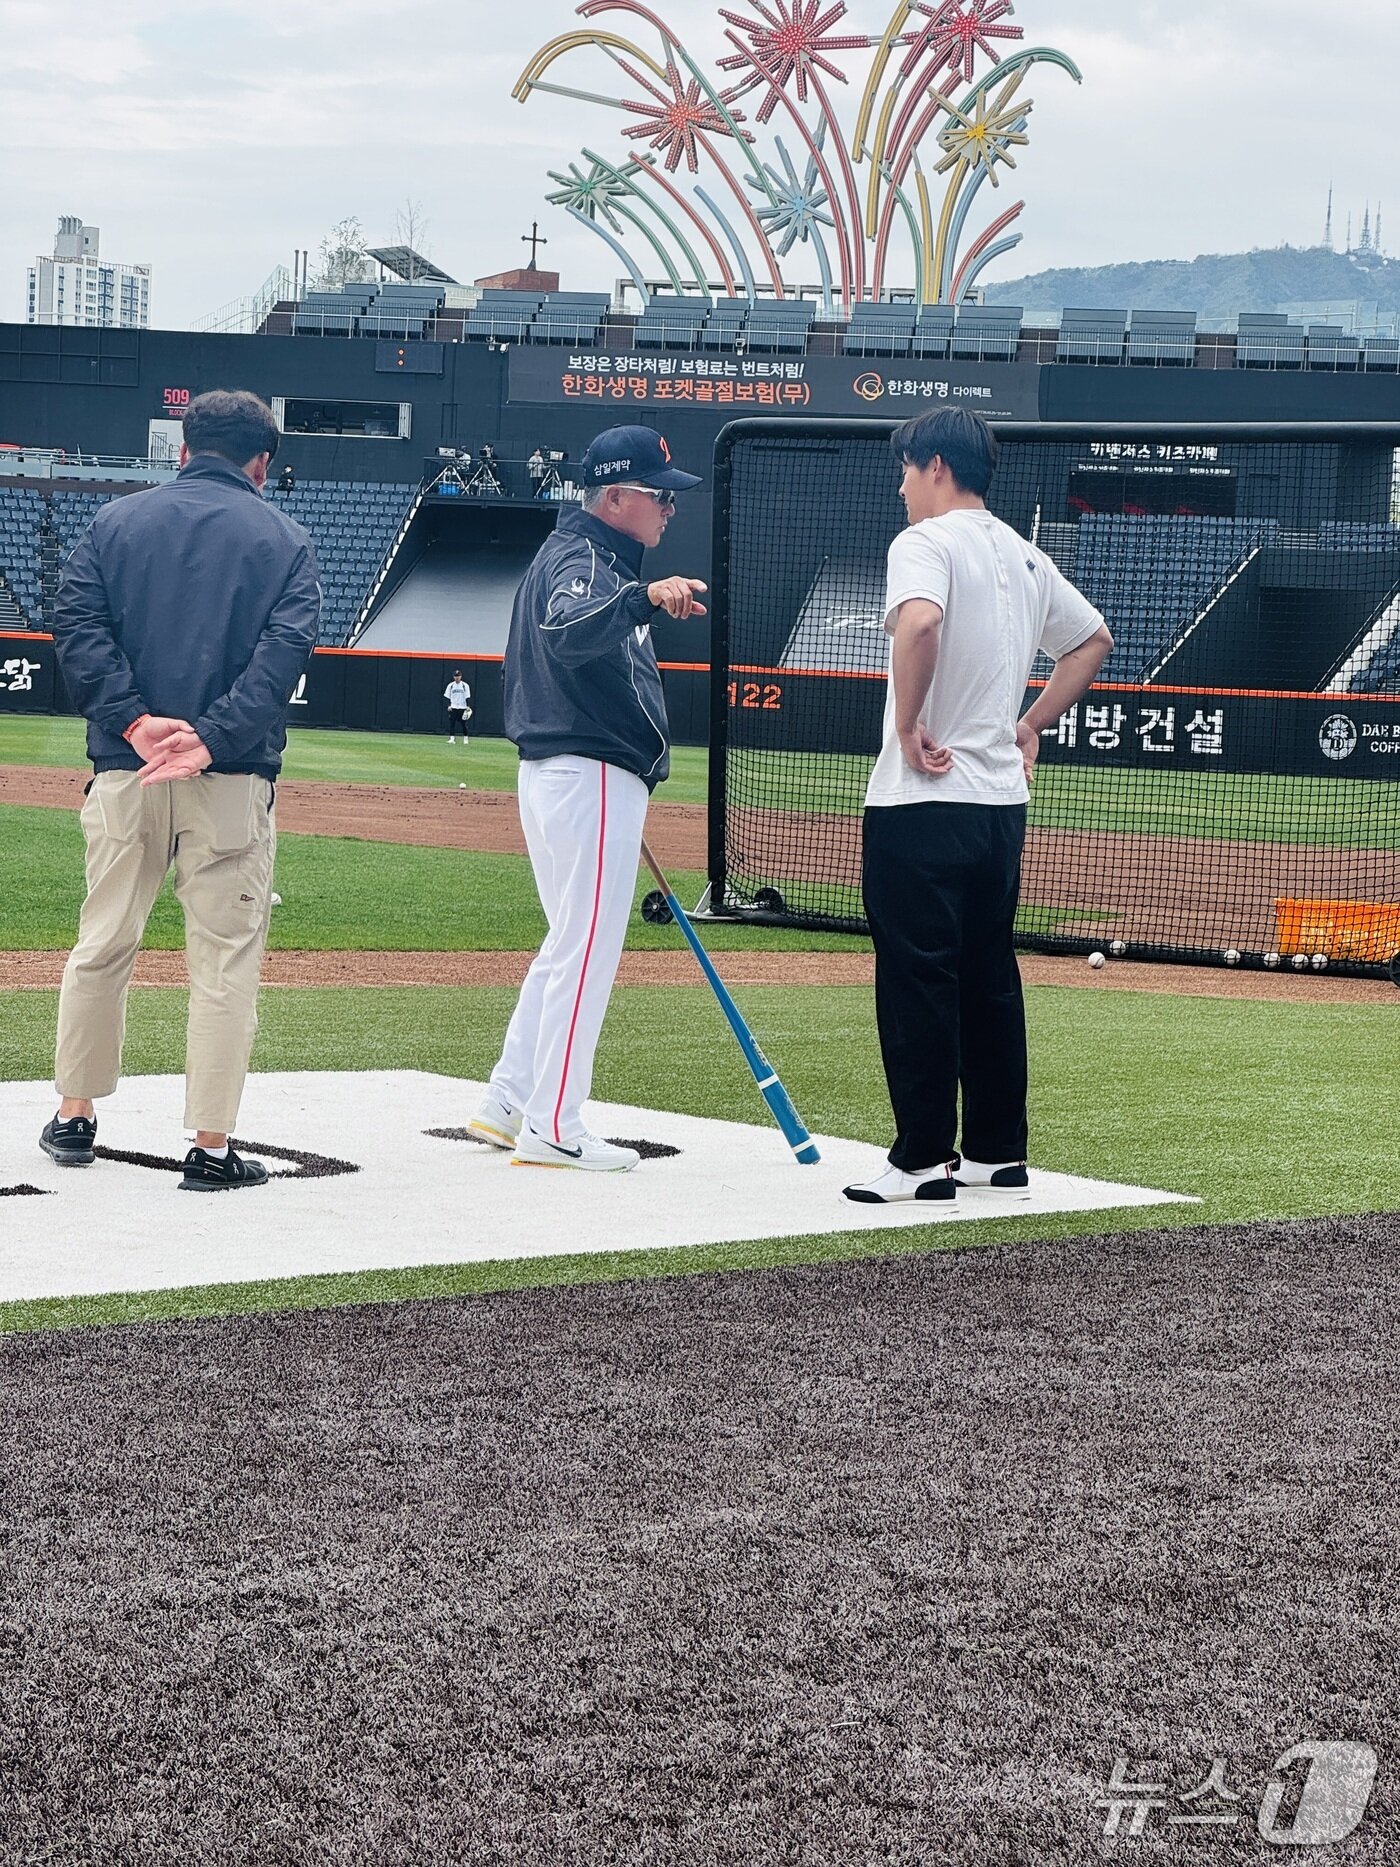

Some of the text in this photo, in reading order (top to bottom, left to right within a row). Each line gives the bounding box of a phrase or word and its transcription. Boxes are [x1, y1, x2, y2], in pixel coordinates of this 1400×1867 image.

[567, 355, 805, 379] 보장은 장타처럼! 보험료는 번트처럼!
[163, 388, 190, 405] 509
[561, 374, 811, 406] 한화생명 포켓골절보험(무)
[887, 380, 993, 399] 한화생명 다이렉트
[593, 459, 631, 477] 삼일제약
[727, 681, 782, 710] 122
[1361, 723, 1390, 738] DAE
